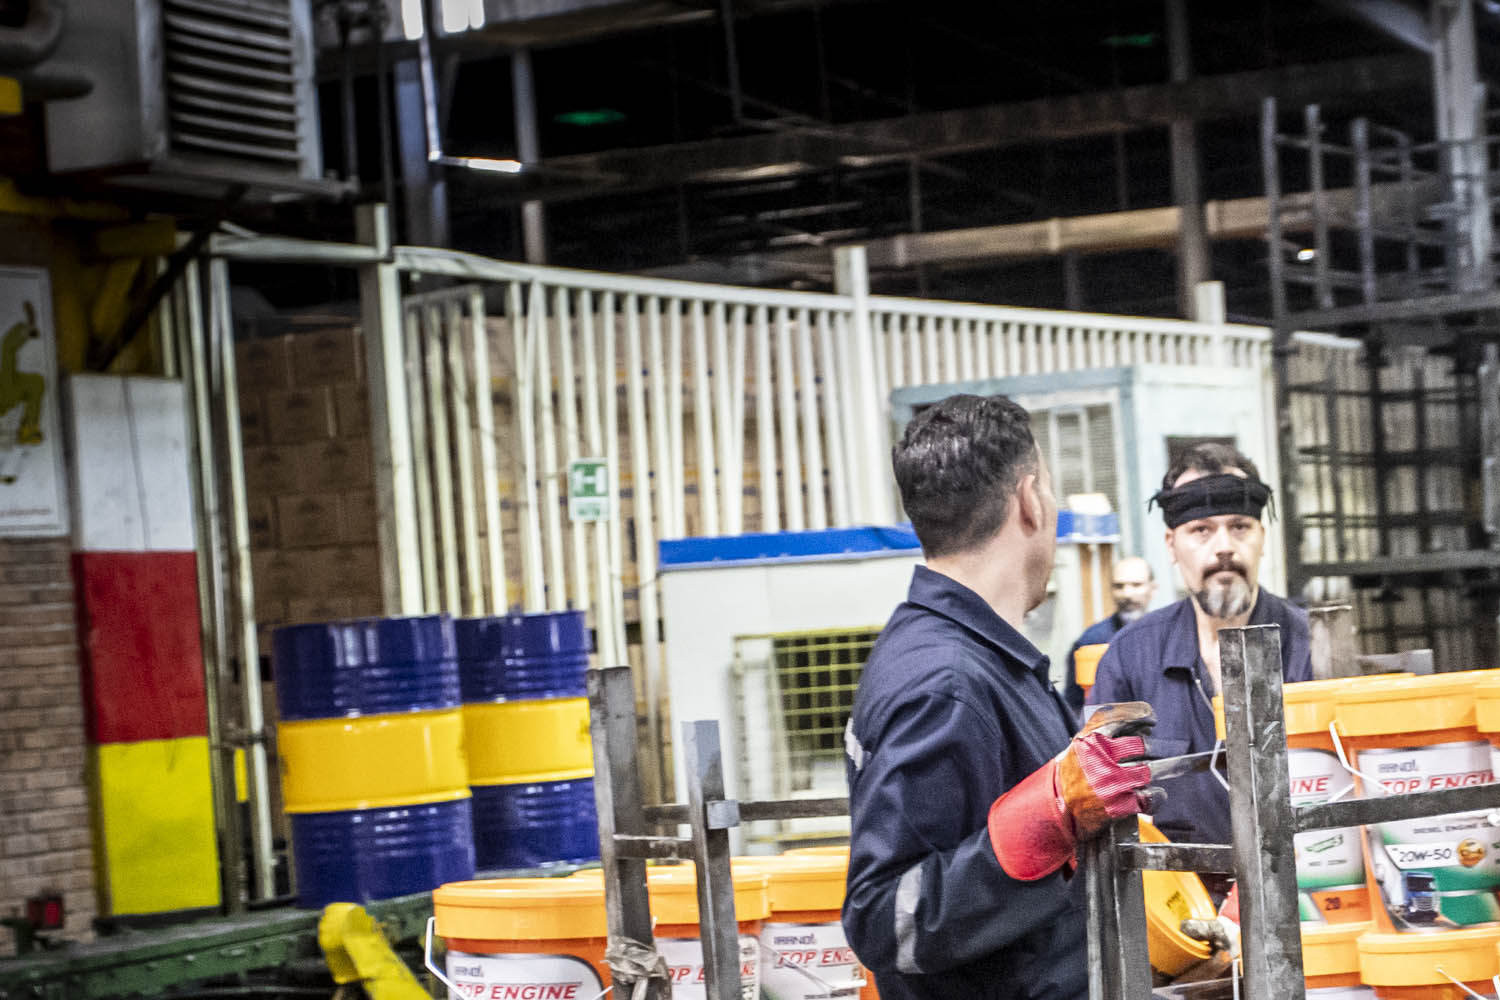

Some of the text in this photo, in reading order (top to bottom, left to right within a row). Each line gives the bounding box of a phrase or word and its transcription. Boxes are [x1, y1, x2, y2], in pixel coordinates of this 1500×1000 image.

[1290, 777, 1329, 795] INE
[1400, 848, 1452, 863] 20W-50
[490, 983, 578, 1000] ENGINE
